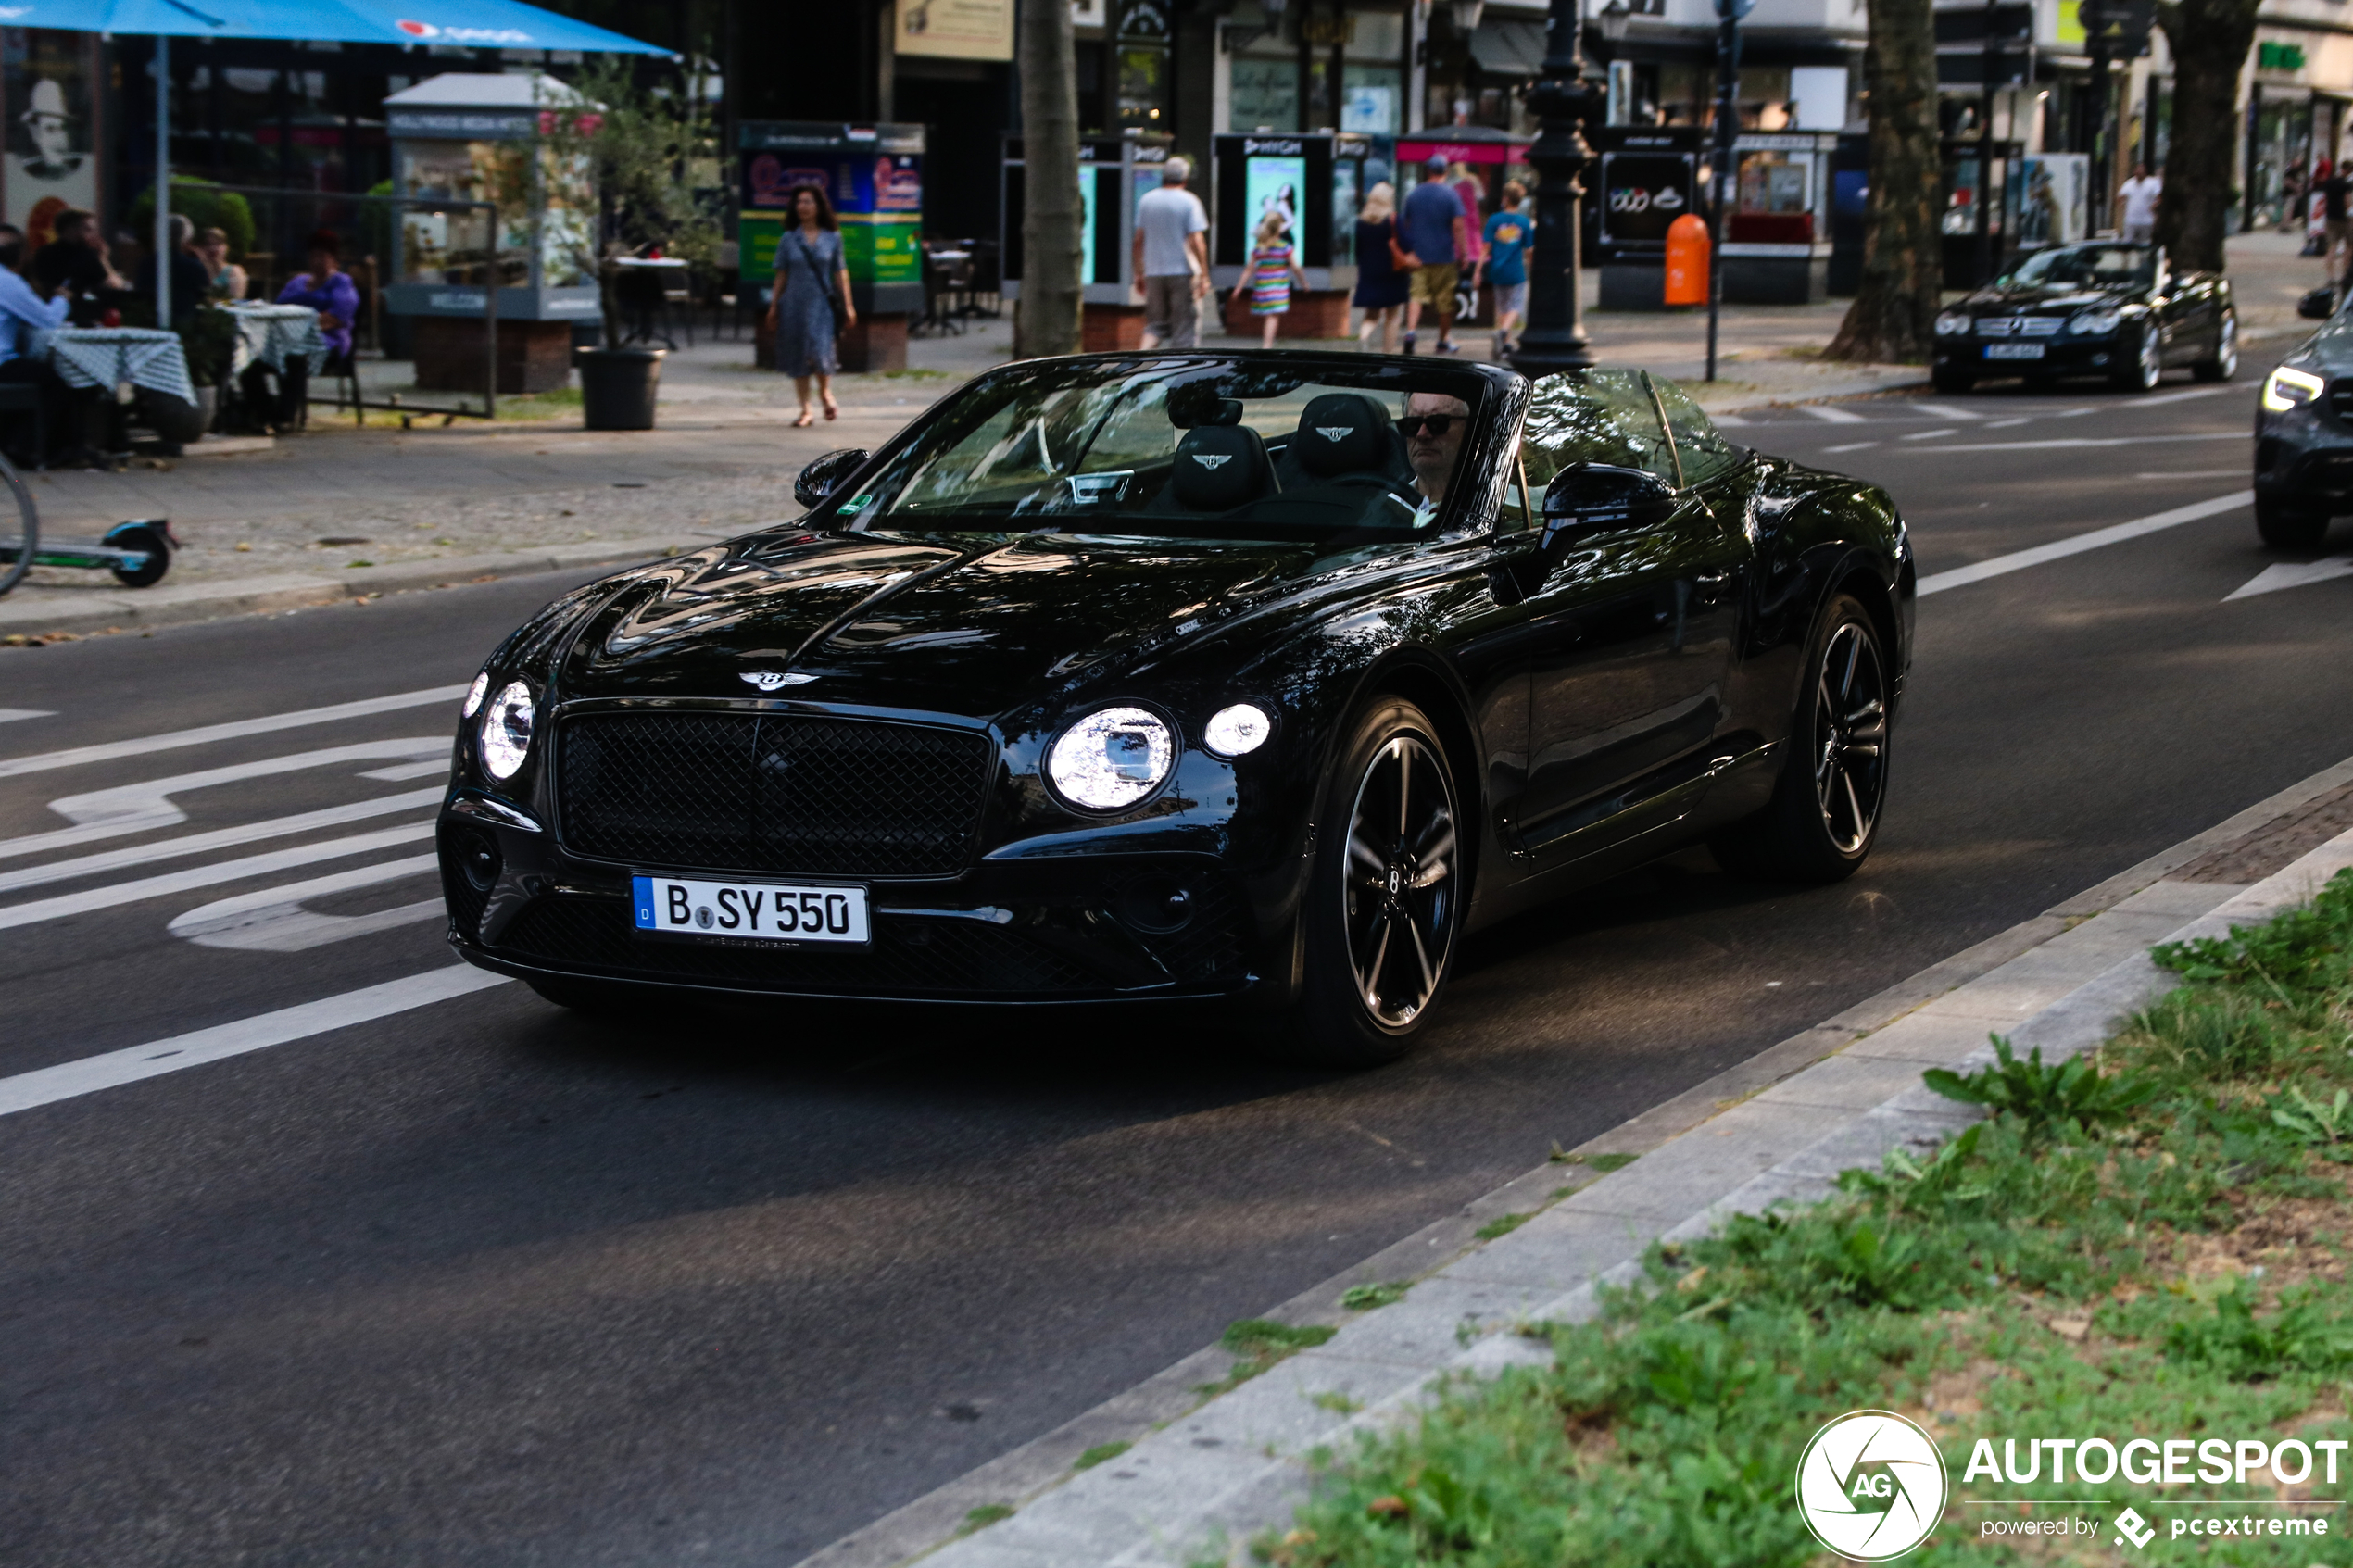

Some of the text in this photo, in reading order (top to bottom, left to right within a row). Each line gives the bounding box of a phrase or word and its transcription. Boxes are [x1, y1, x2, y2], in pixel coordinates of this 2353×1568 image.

[641, 908, 650, 920] D
[668, 884, 849, 934] B SY 550
